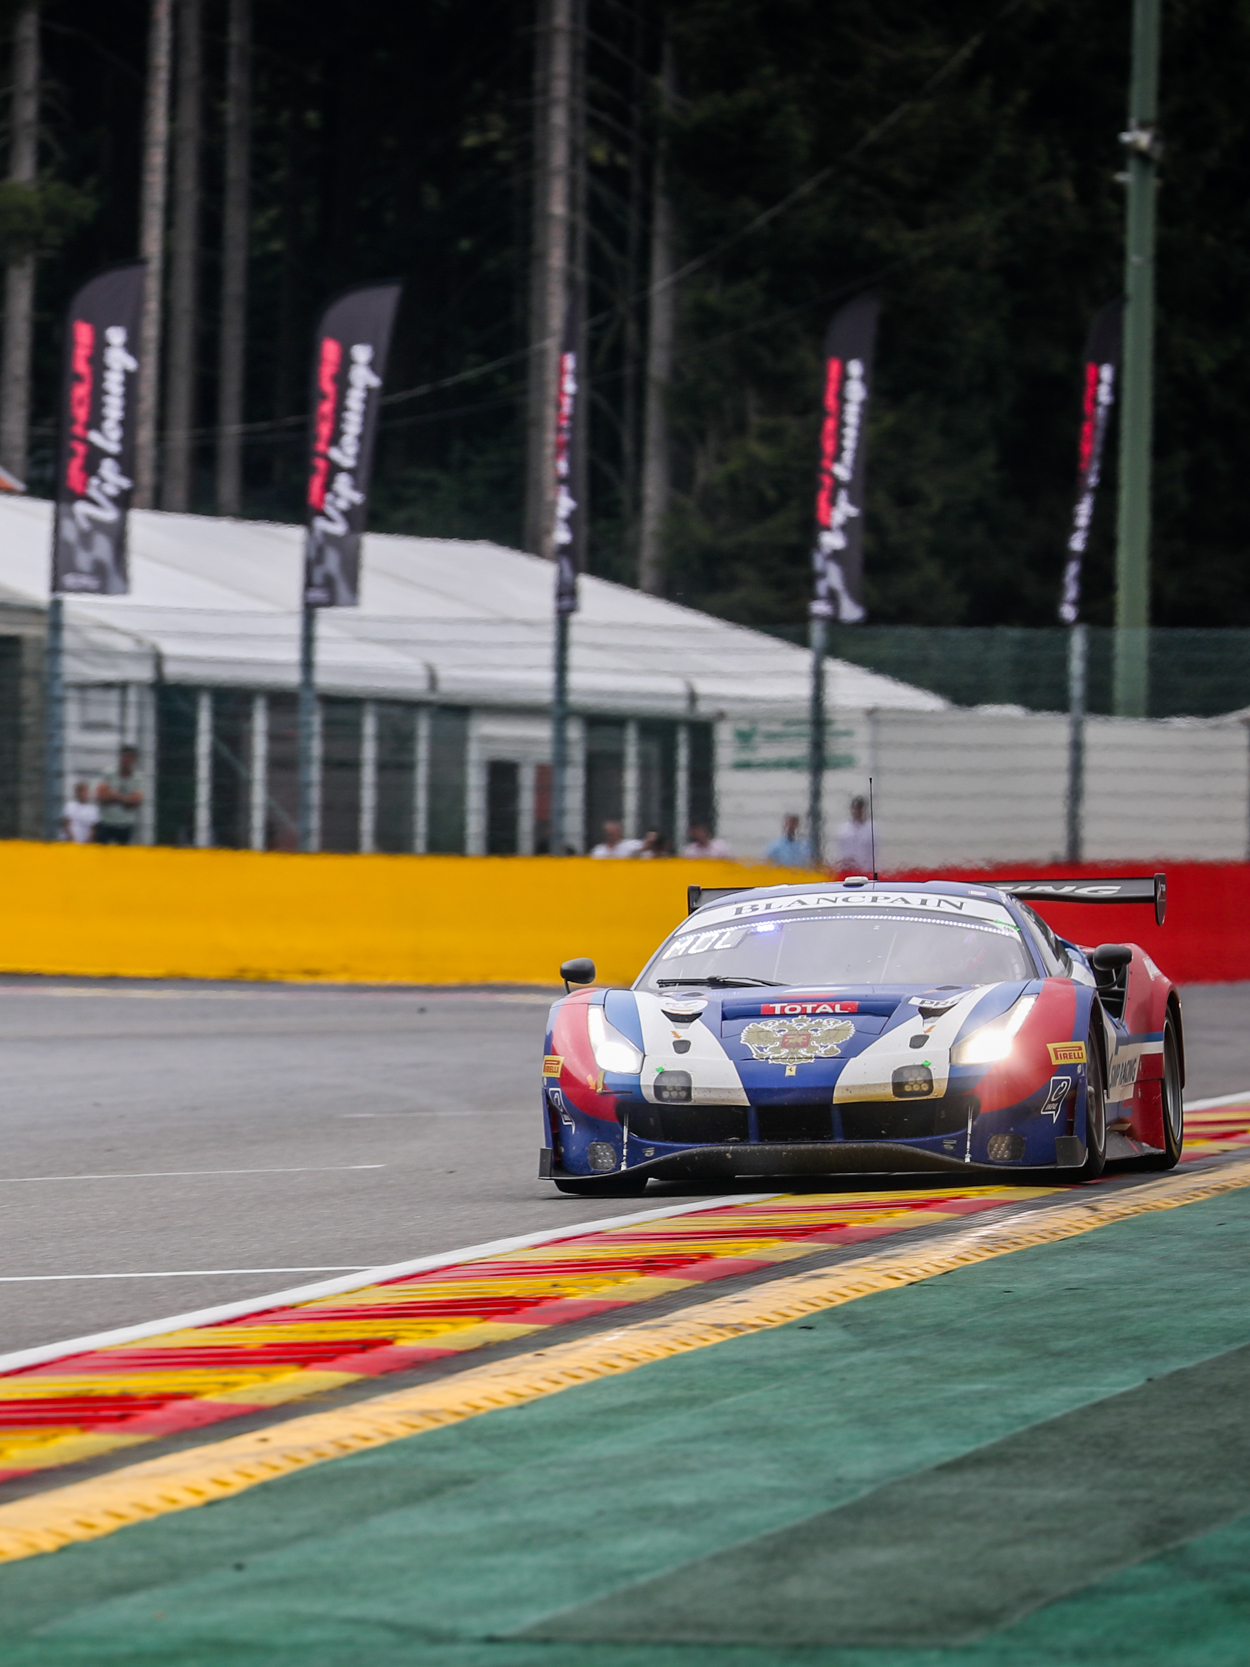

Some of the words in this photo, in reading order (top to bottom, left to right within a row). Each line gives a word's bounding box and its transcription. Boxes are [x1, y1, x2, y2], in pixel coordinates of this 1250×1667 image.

[88, 326, 138, 454] lounge
[328, 343, 382, 468] lounge
[73, 457, 132, 531] Vip
[313, 472, 365, 537] Vip
[734, 895, 967, 916] BLANCPAIN
[661, 930, 732, 960] MOL
[769, 1002, 851, 1015] TOTAL
[1052, 1045, 1084, 1061] PIRELLI
